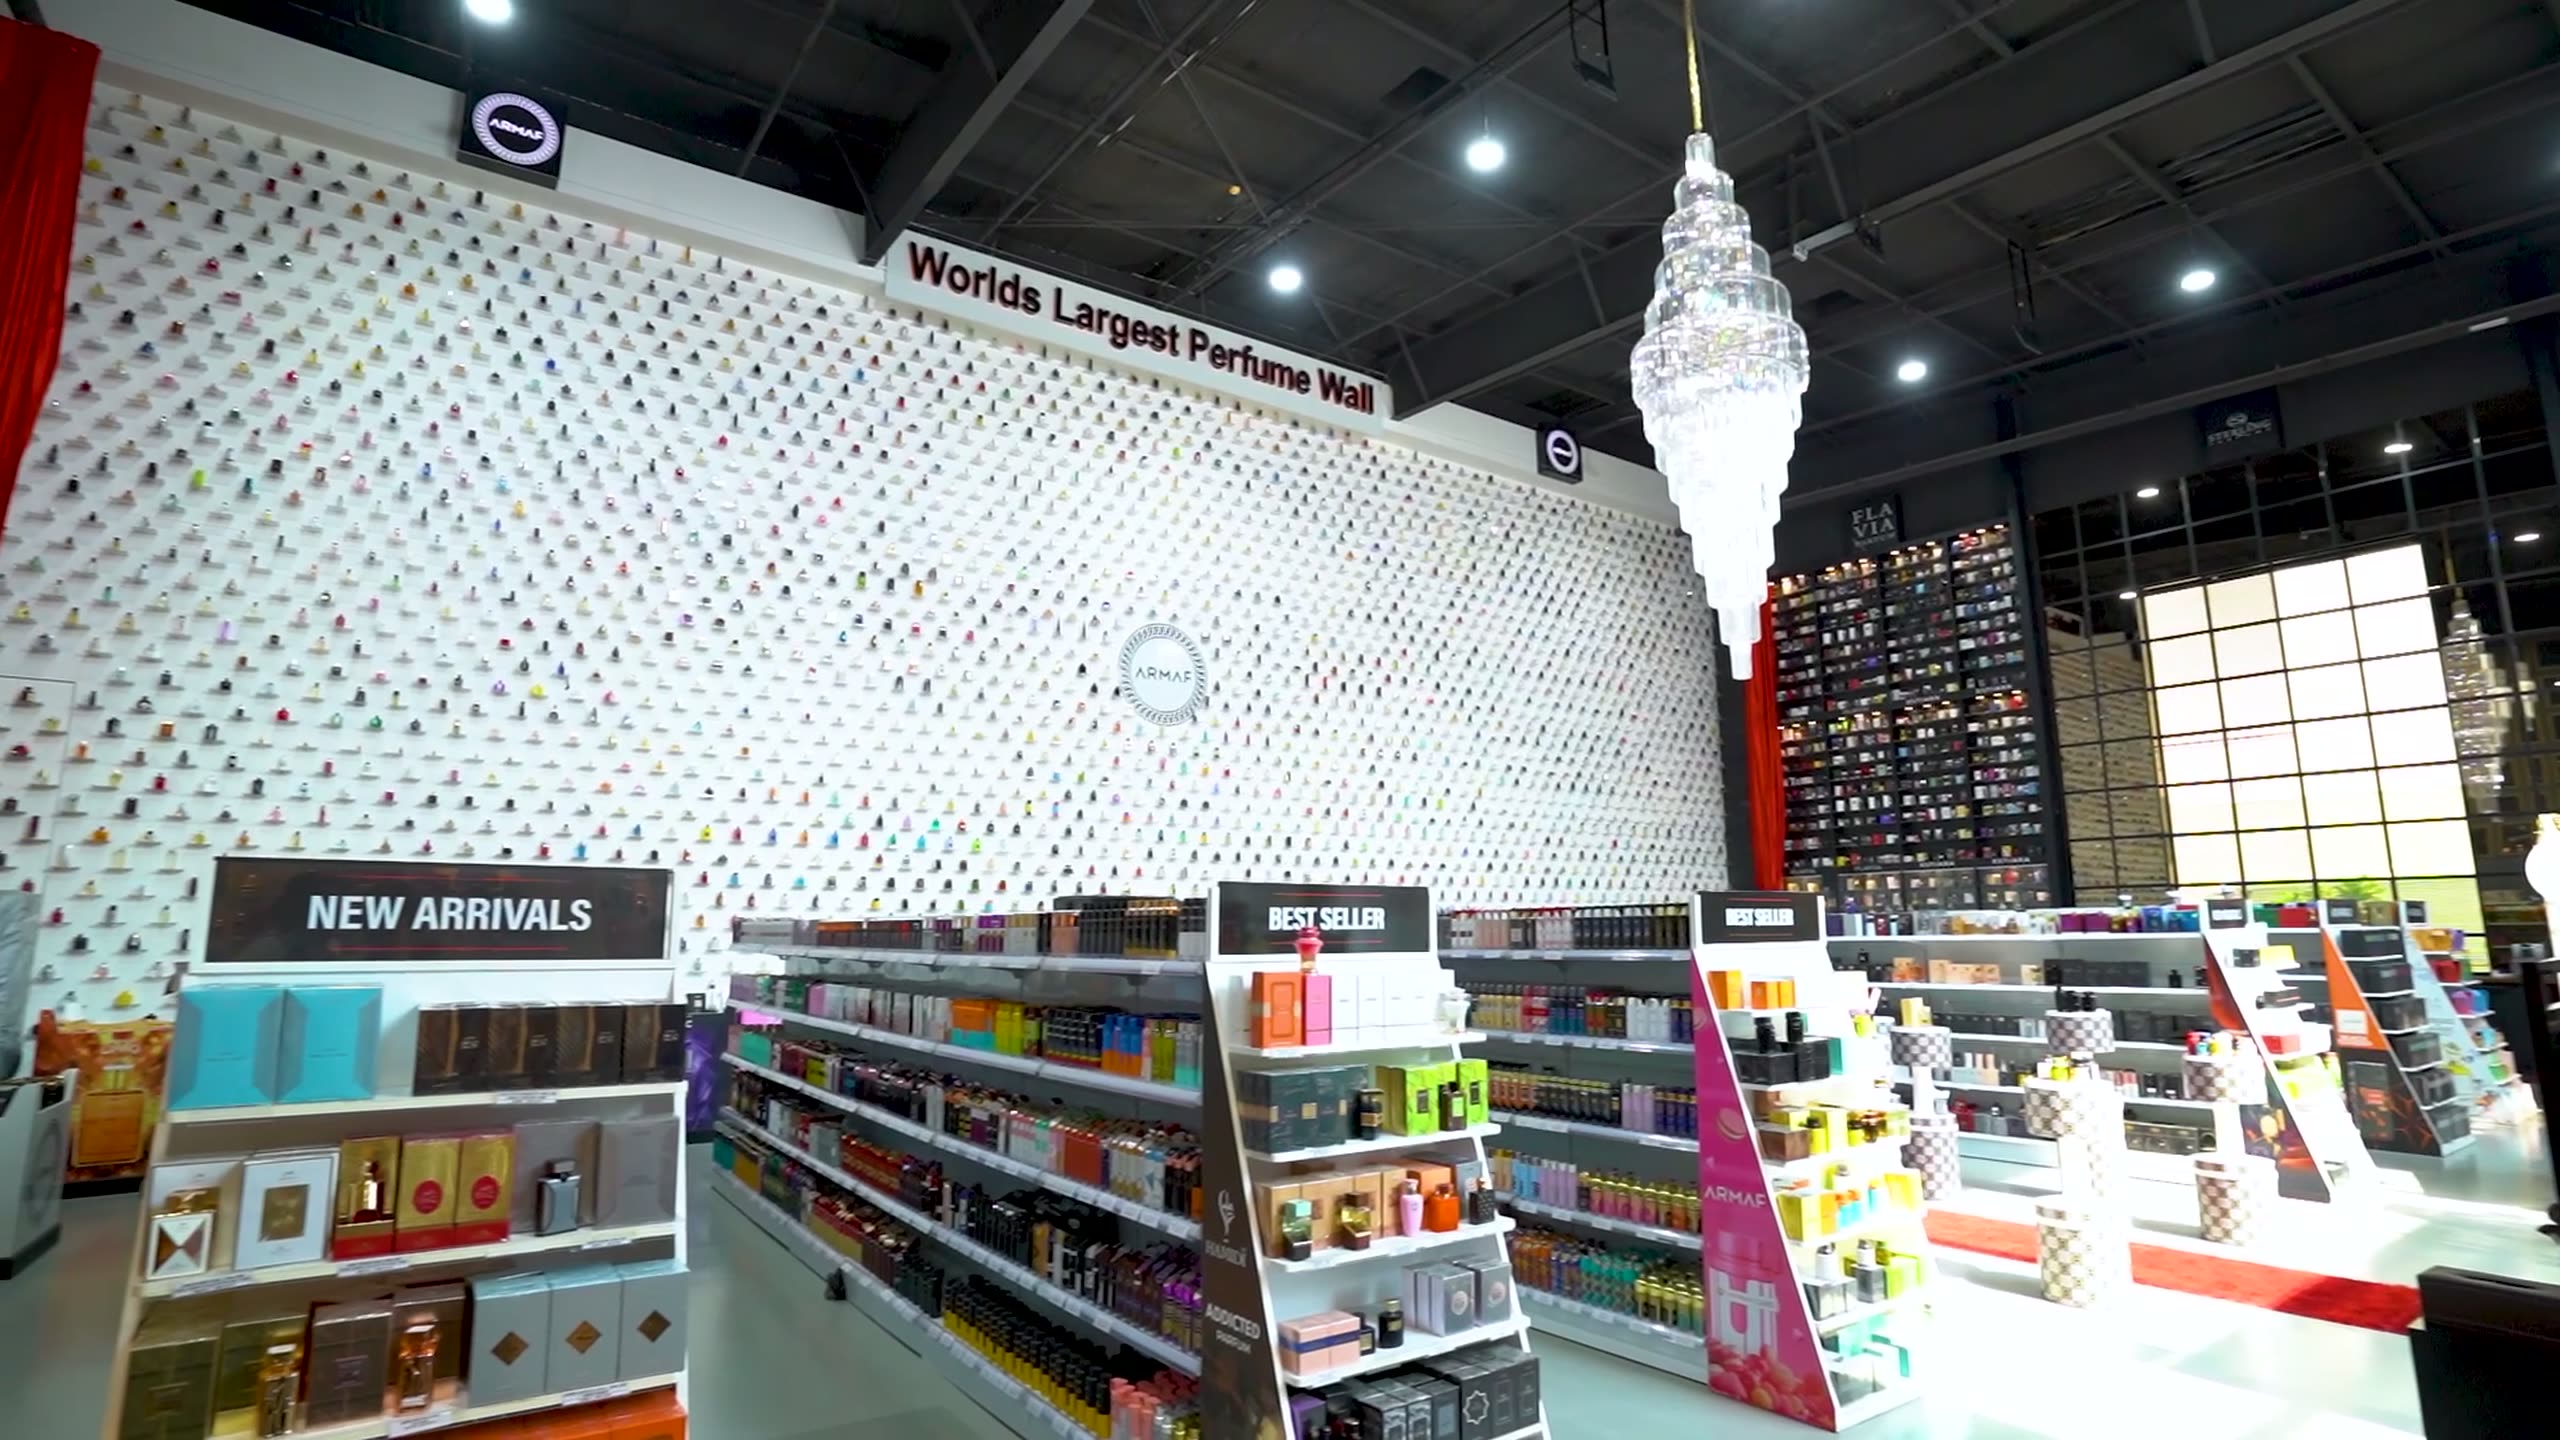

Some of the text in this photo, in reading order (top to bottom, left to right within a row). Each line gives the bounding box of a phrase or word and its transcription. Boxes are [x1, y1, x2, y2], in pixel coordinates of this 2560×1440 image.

[489, 118, 544, 141] ARMAF
[908, 241, 1374, 415] Worlds Largest Perfume Wall
[1852, 503, 1893, 524] FLA
[1853, 518, 1895, 537] VIA
[1135, 666, 1192, 683] ARMAF
[306, 895, 593, 931] NEW ARRIVALS
[1268, 906, 1385, 931] BEST SELLER
[1704, 1185, 1766, 1208] ARMAF
[1205, 1302, 1261, 1340] ADDICTED
